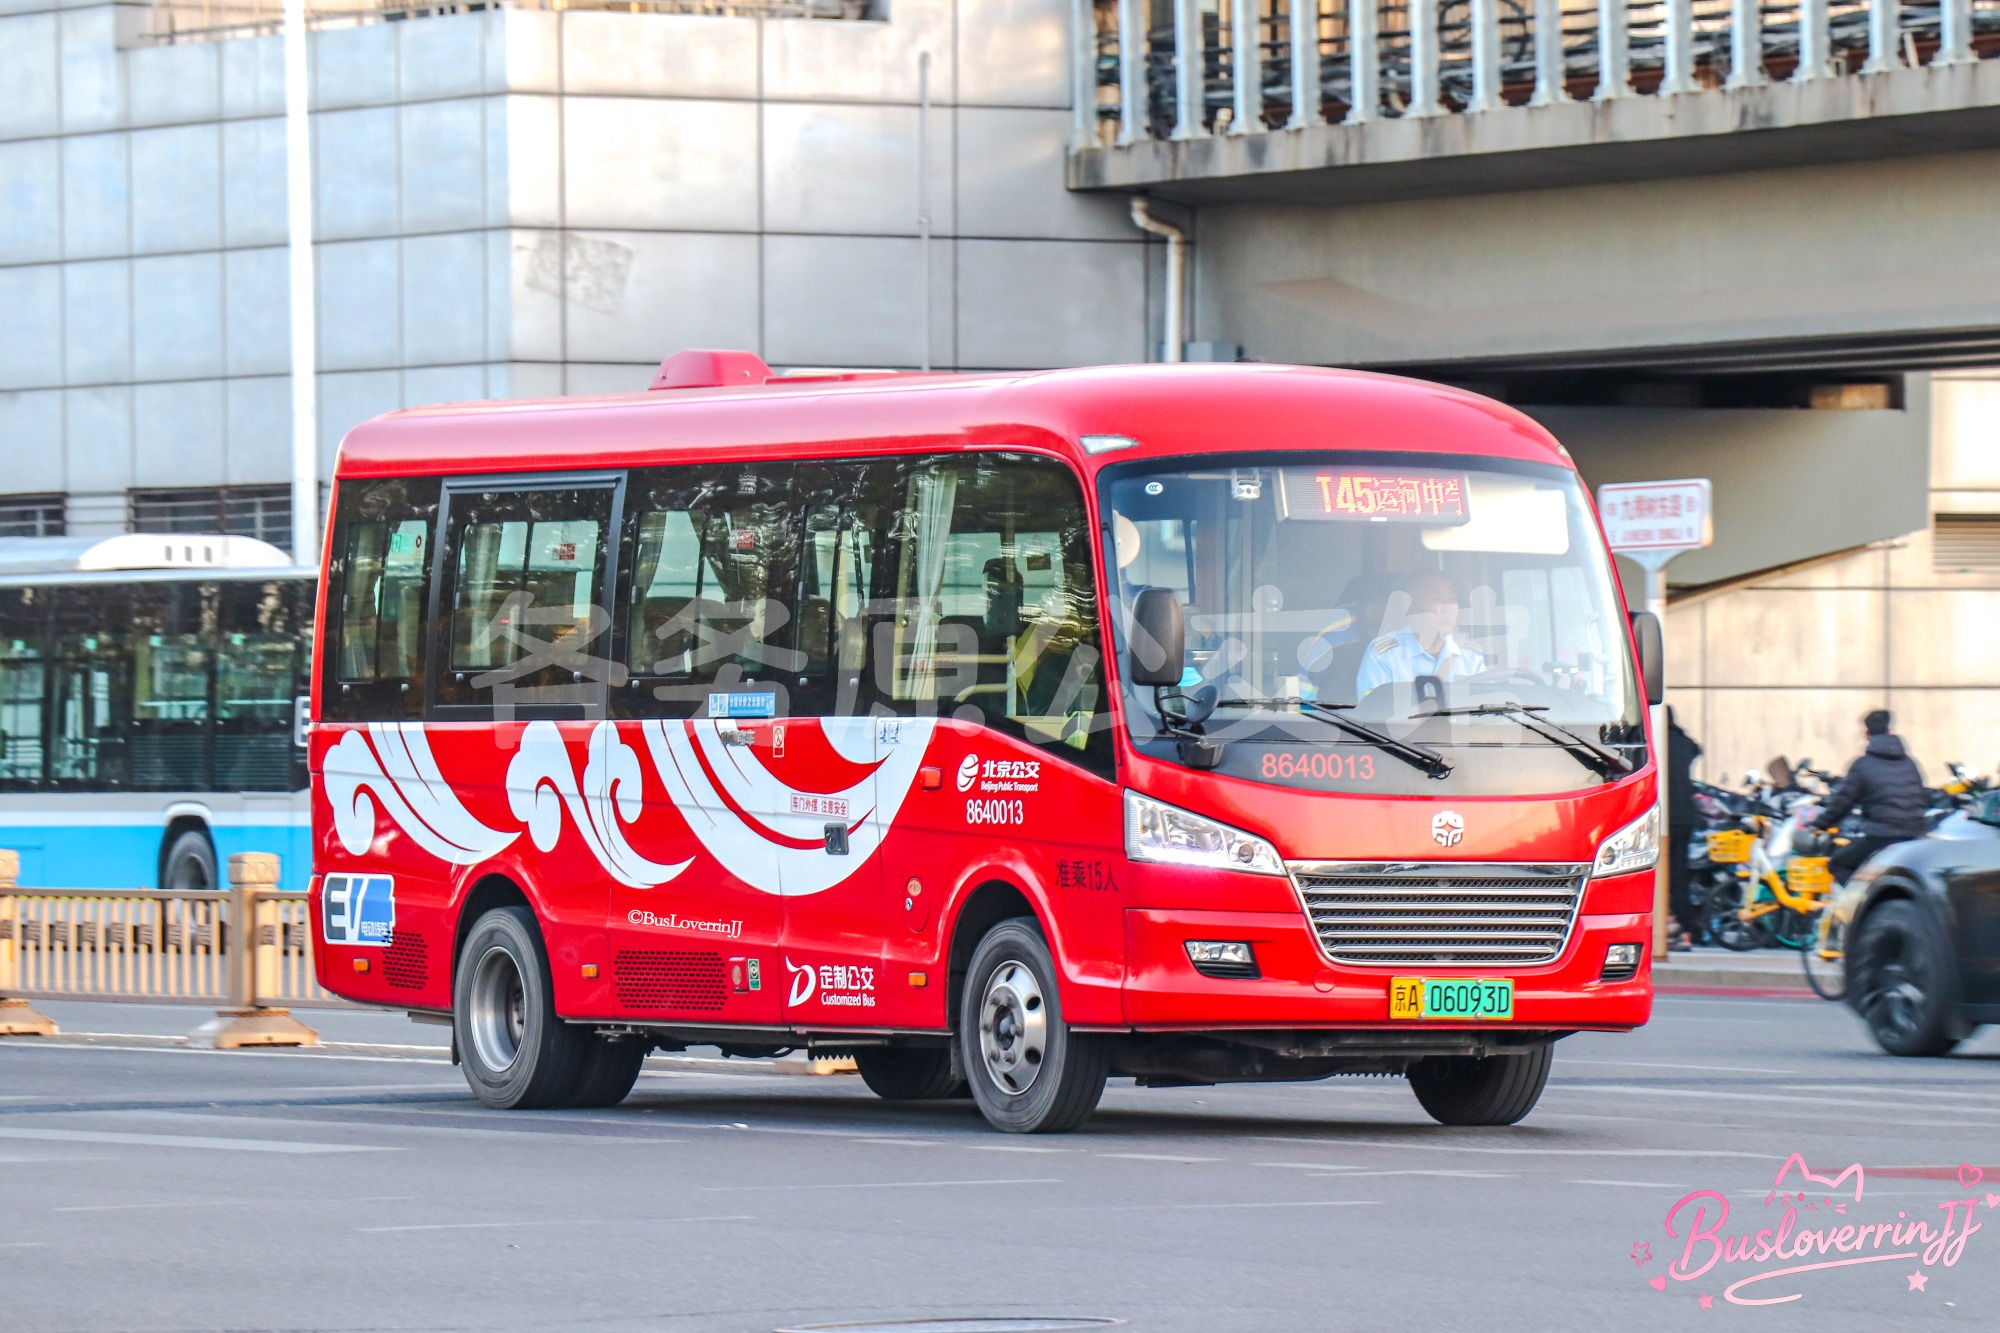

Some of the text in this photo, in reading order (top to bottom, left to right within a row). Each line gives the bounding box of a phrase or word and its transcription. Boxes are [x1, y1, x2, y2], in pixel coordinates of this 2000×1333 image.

[982, 760, 1040, 779] 北京公交
[1261, 753, 1375, 781] 8640013
[981, 781, 1038, 794] Beijing Public Transport
[821, 799, 847, 816] 注意安全
[966, 799, 1024, 825] 8640013
[1054, 860, 1119, 894] 准乘15人
[325, 877, 369, 941] EV
[361, 921, 389, 936] 电动汽车
[819, 965, 875, 990] 定制公交
[821, 991, 876, 1007] Customized Bus
